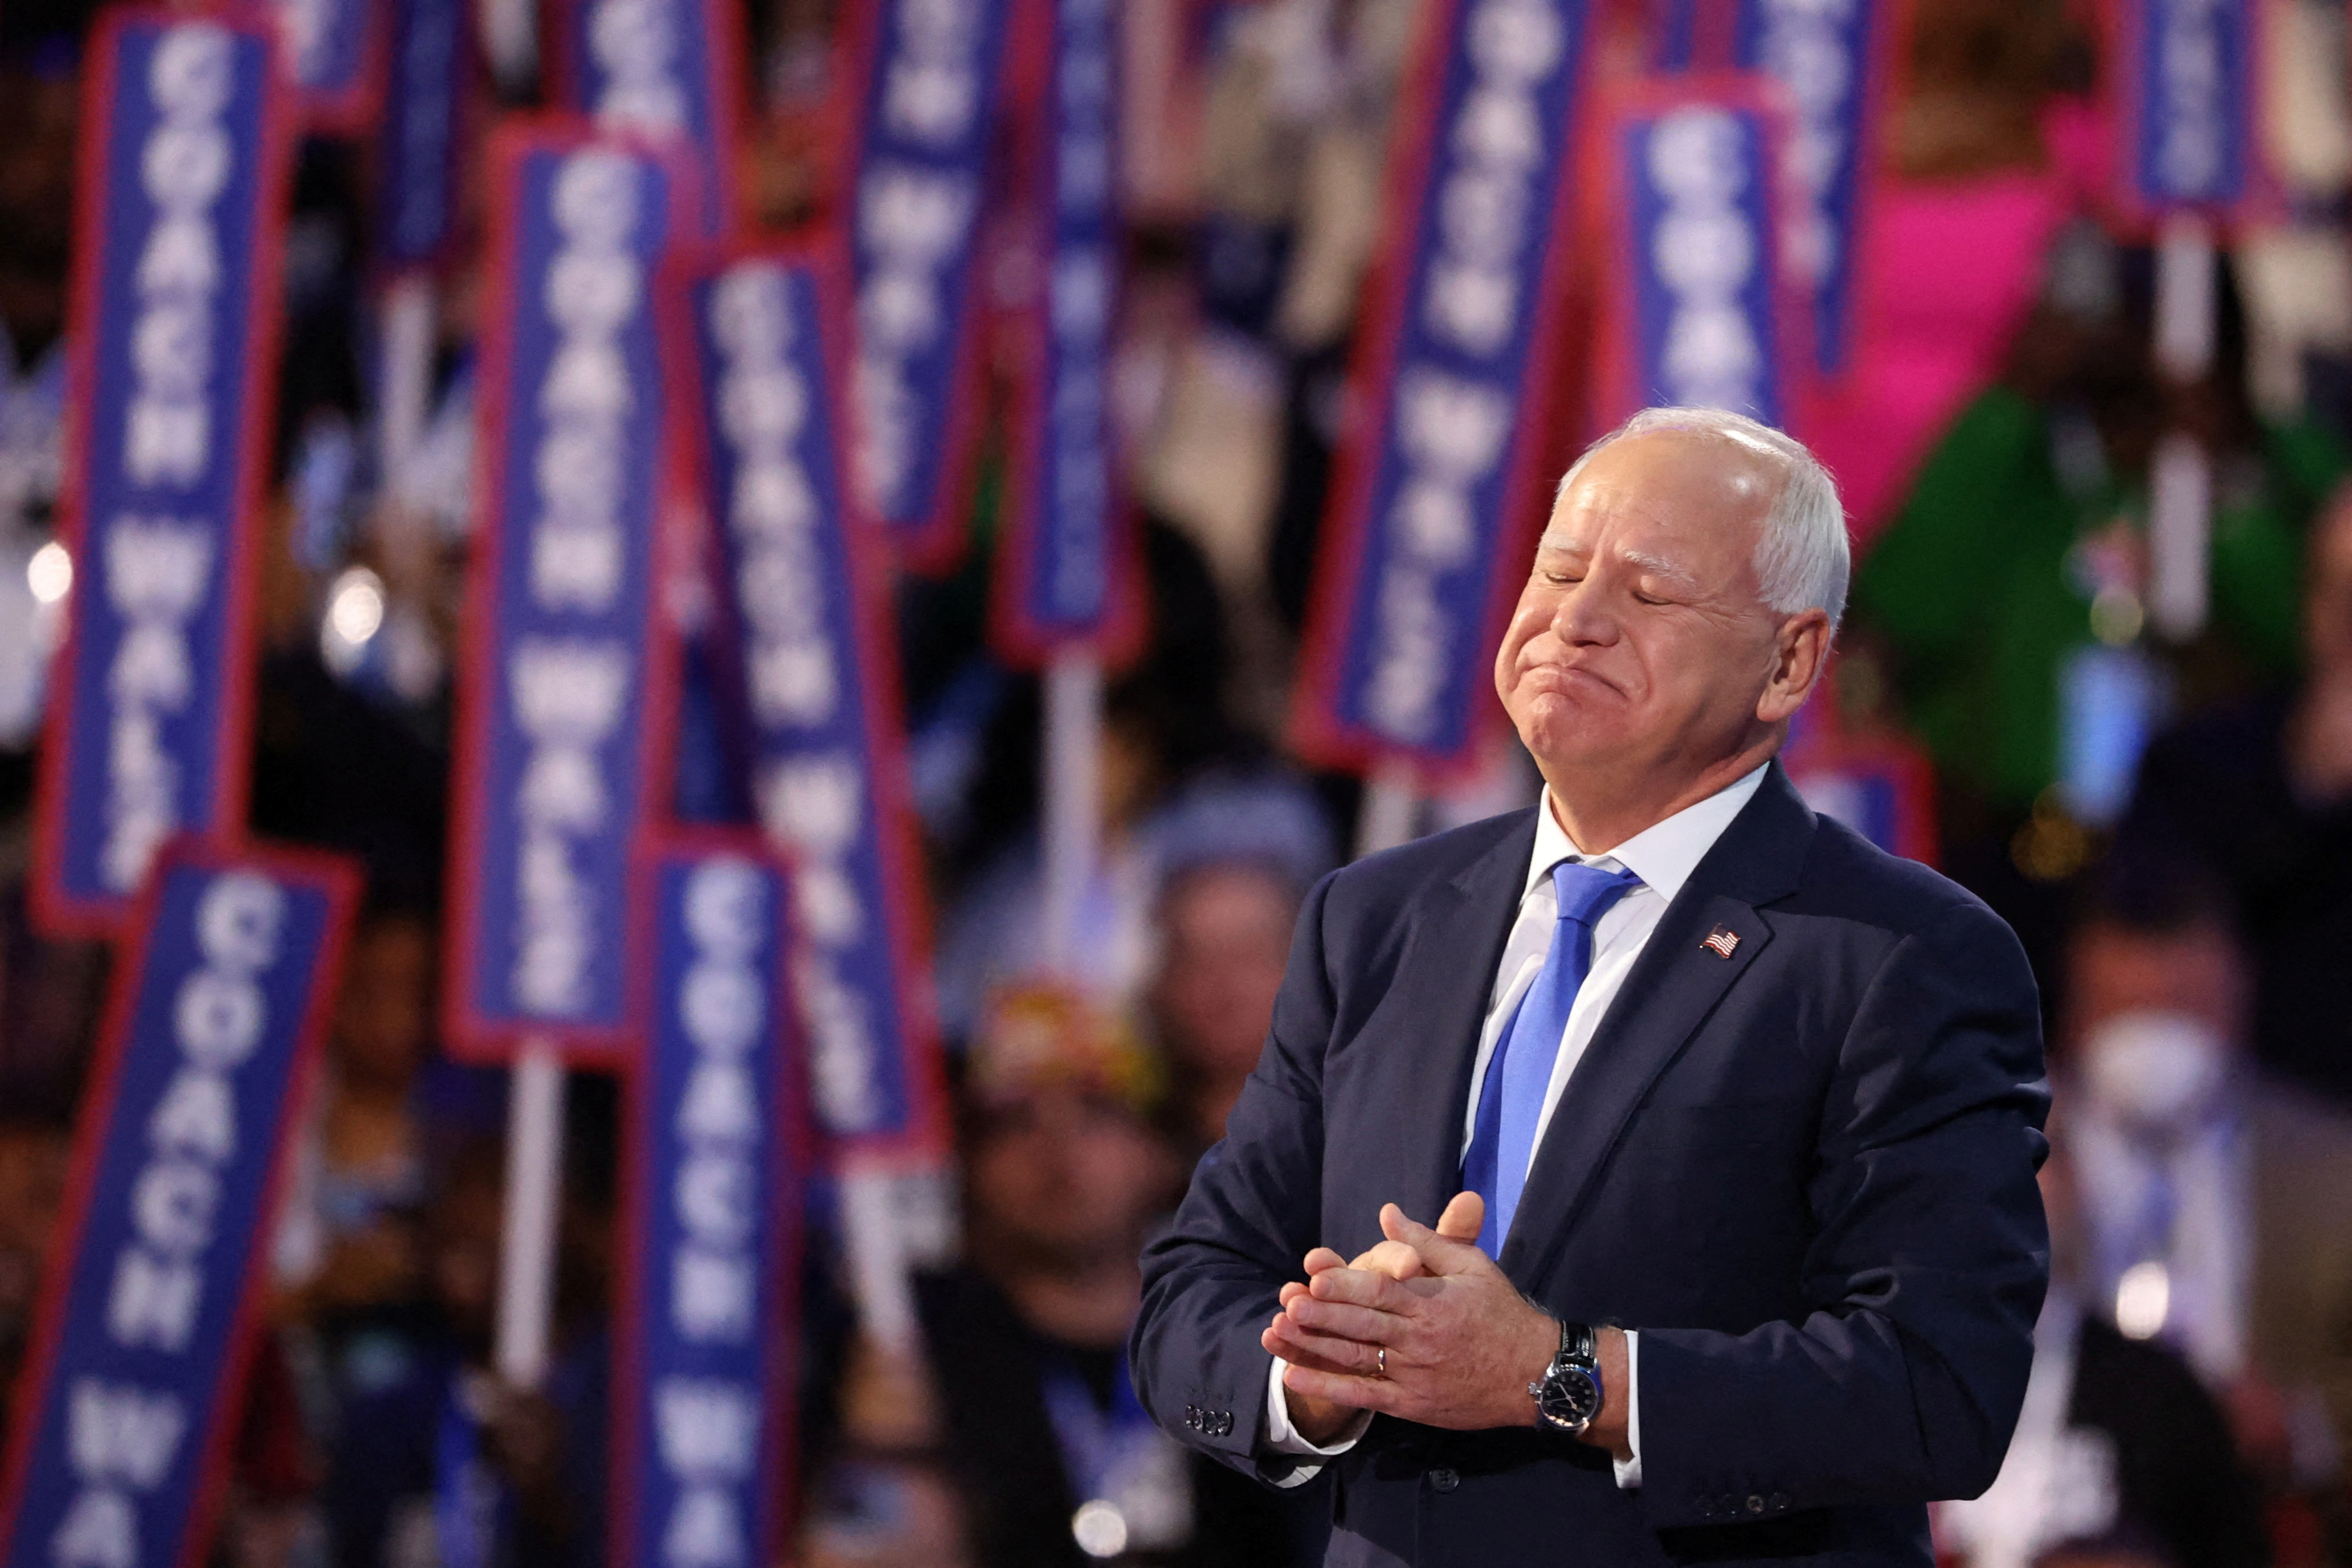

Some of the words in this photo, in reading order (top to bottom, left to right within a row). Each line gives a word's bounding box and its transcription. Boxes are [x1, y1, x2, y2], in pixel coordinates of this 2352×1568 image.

[125, 22, 234, 490] COACH
[534, 149, 641, 611] COACH
[709, 263, 836, 726] COACH
[510, 638, 630, 1011] WALZ
[109, 872, 285, 1350] COACH
[672, 856, 765, 1344] COACH
